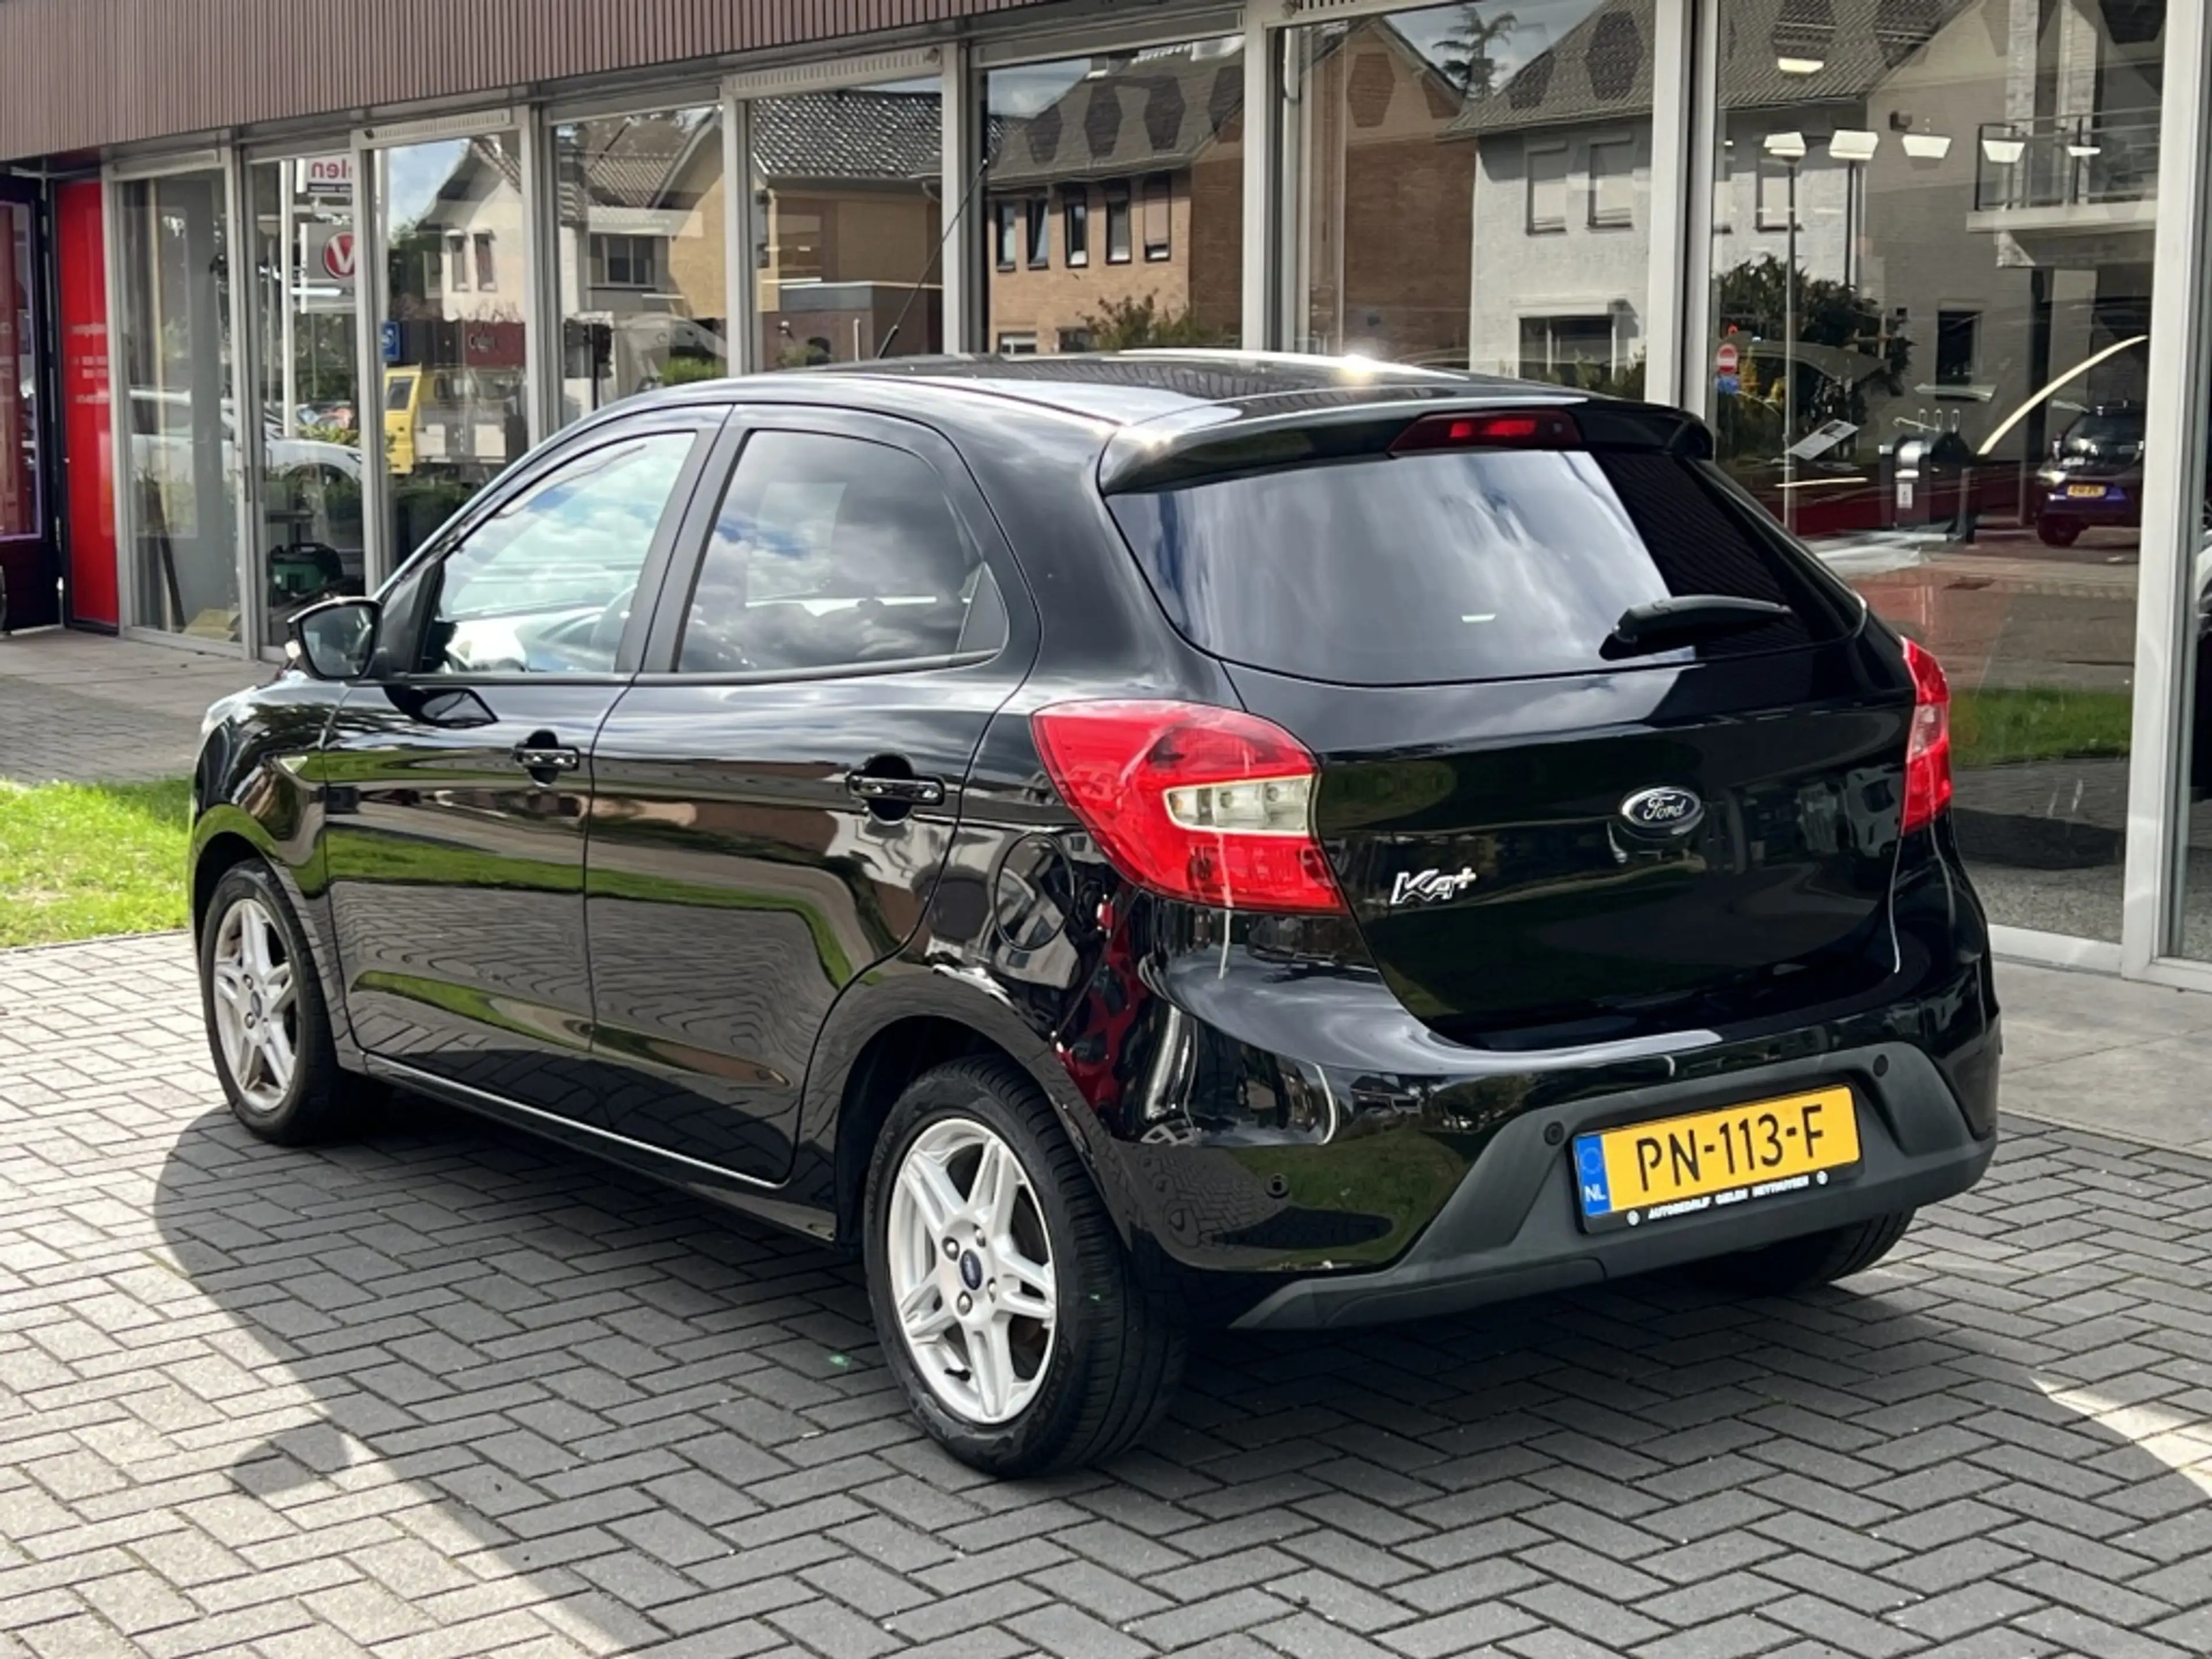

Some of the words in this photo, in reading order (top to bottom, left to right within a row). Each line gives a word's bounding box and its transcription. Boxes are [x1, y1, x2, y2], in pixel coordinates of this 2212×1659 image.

[1643, 795, 1687, 820] Ford
[1636, 1104, 1824, 1192] PN-113-F
[1584, 1187, 1607, 1202] NL
